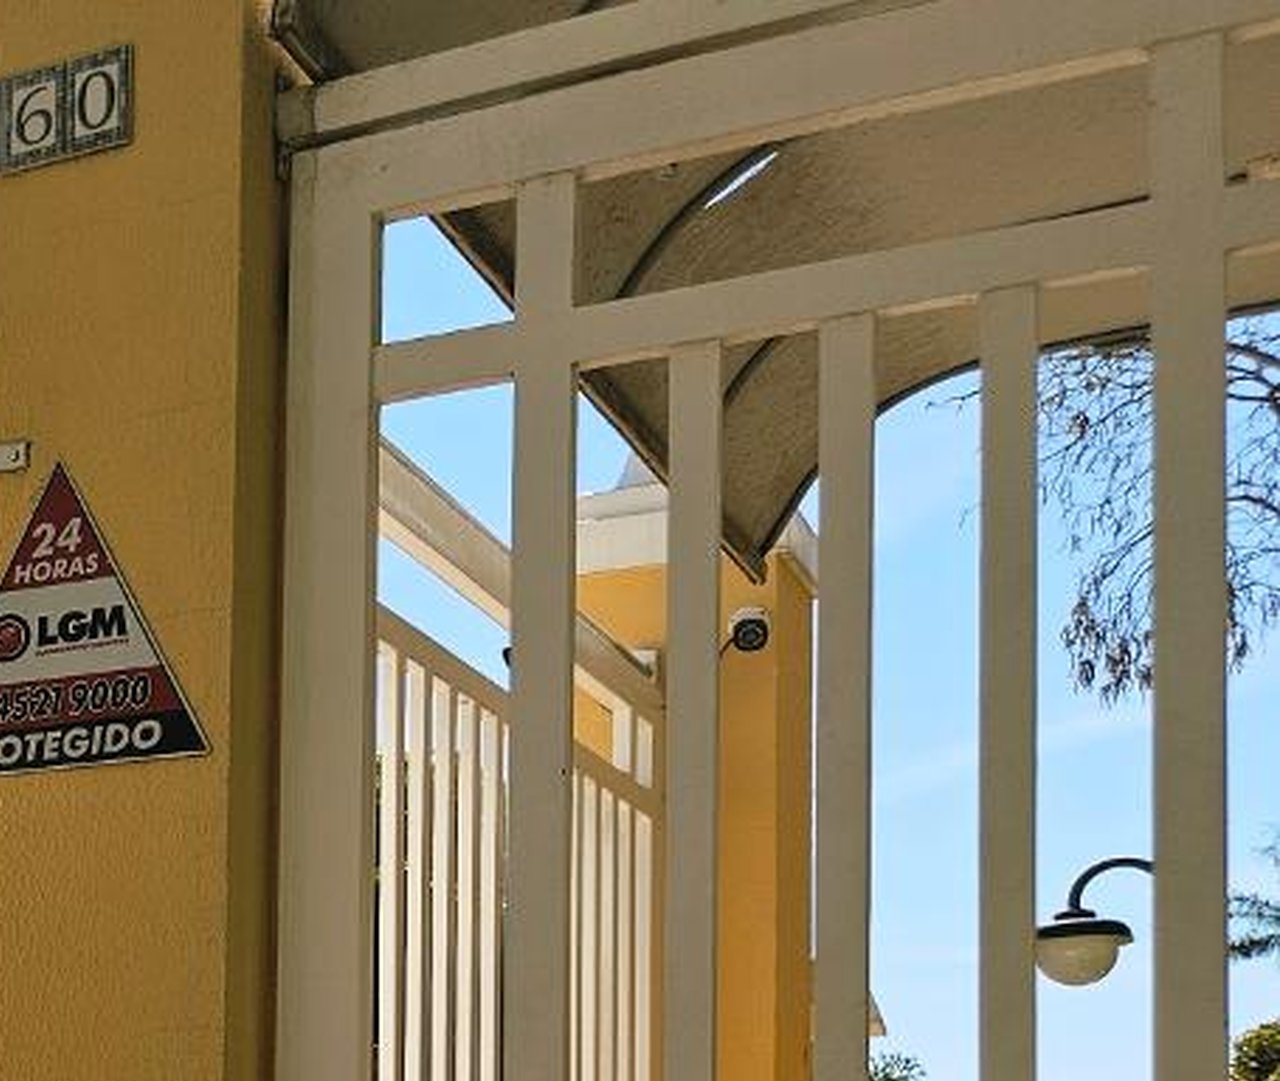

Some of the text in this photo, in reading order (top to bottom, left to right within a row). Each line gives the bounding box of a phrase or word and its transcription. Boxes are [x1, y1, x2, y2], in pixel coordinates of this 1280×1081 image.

[32, 516, 82, 559] 24
[14, 552, 99, 584] HORAS
[37, 604, 128, 647] LGM
[68, 672, 152, 717] 9000
